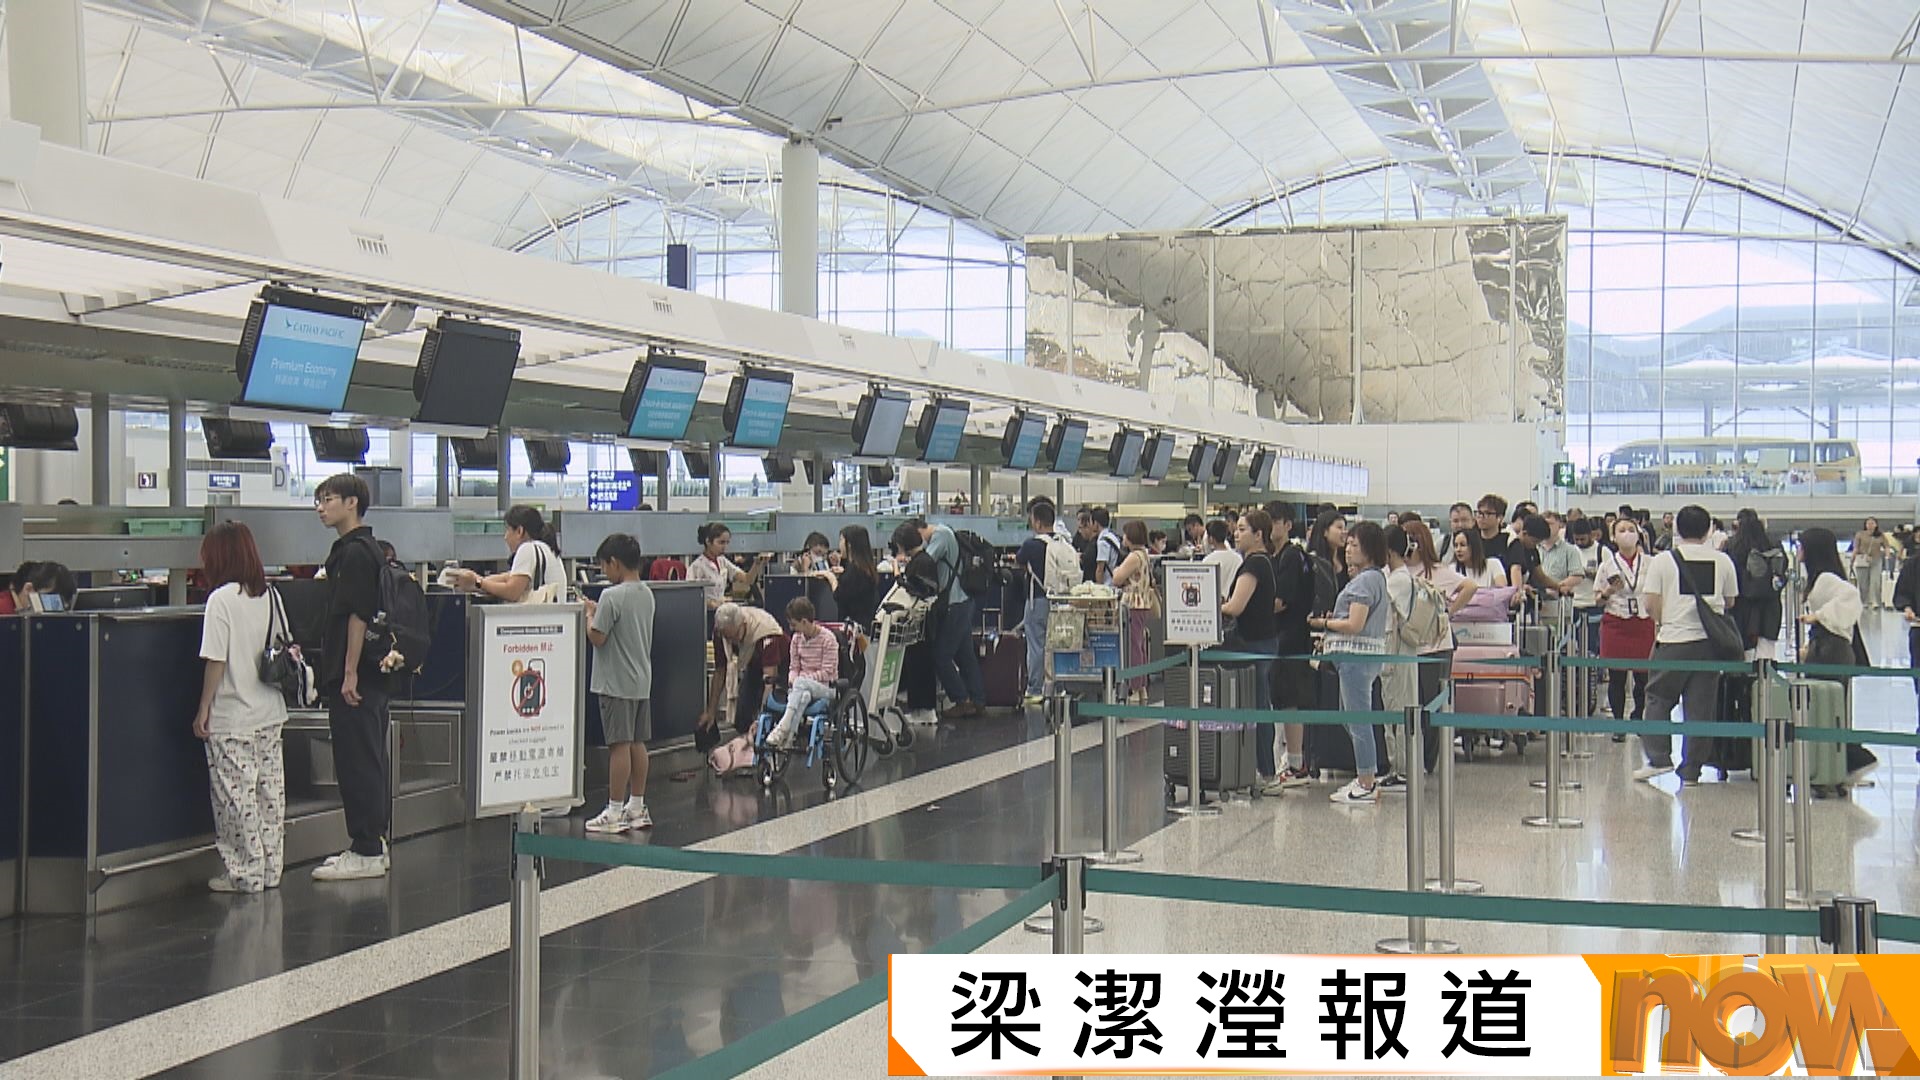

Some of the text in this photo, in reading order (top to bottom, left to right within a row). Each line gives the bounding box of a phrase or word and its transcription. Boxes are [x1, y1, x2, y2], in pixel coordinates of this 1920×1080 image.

[293, 322, 319, 336] CATHAY
[271, 358, 337, 379] Premium Economy
[275, 466, 285, 487] D
[503, 643, 538, 653] Forbidden
